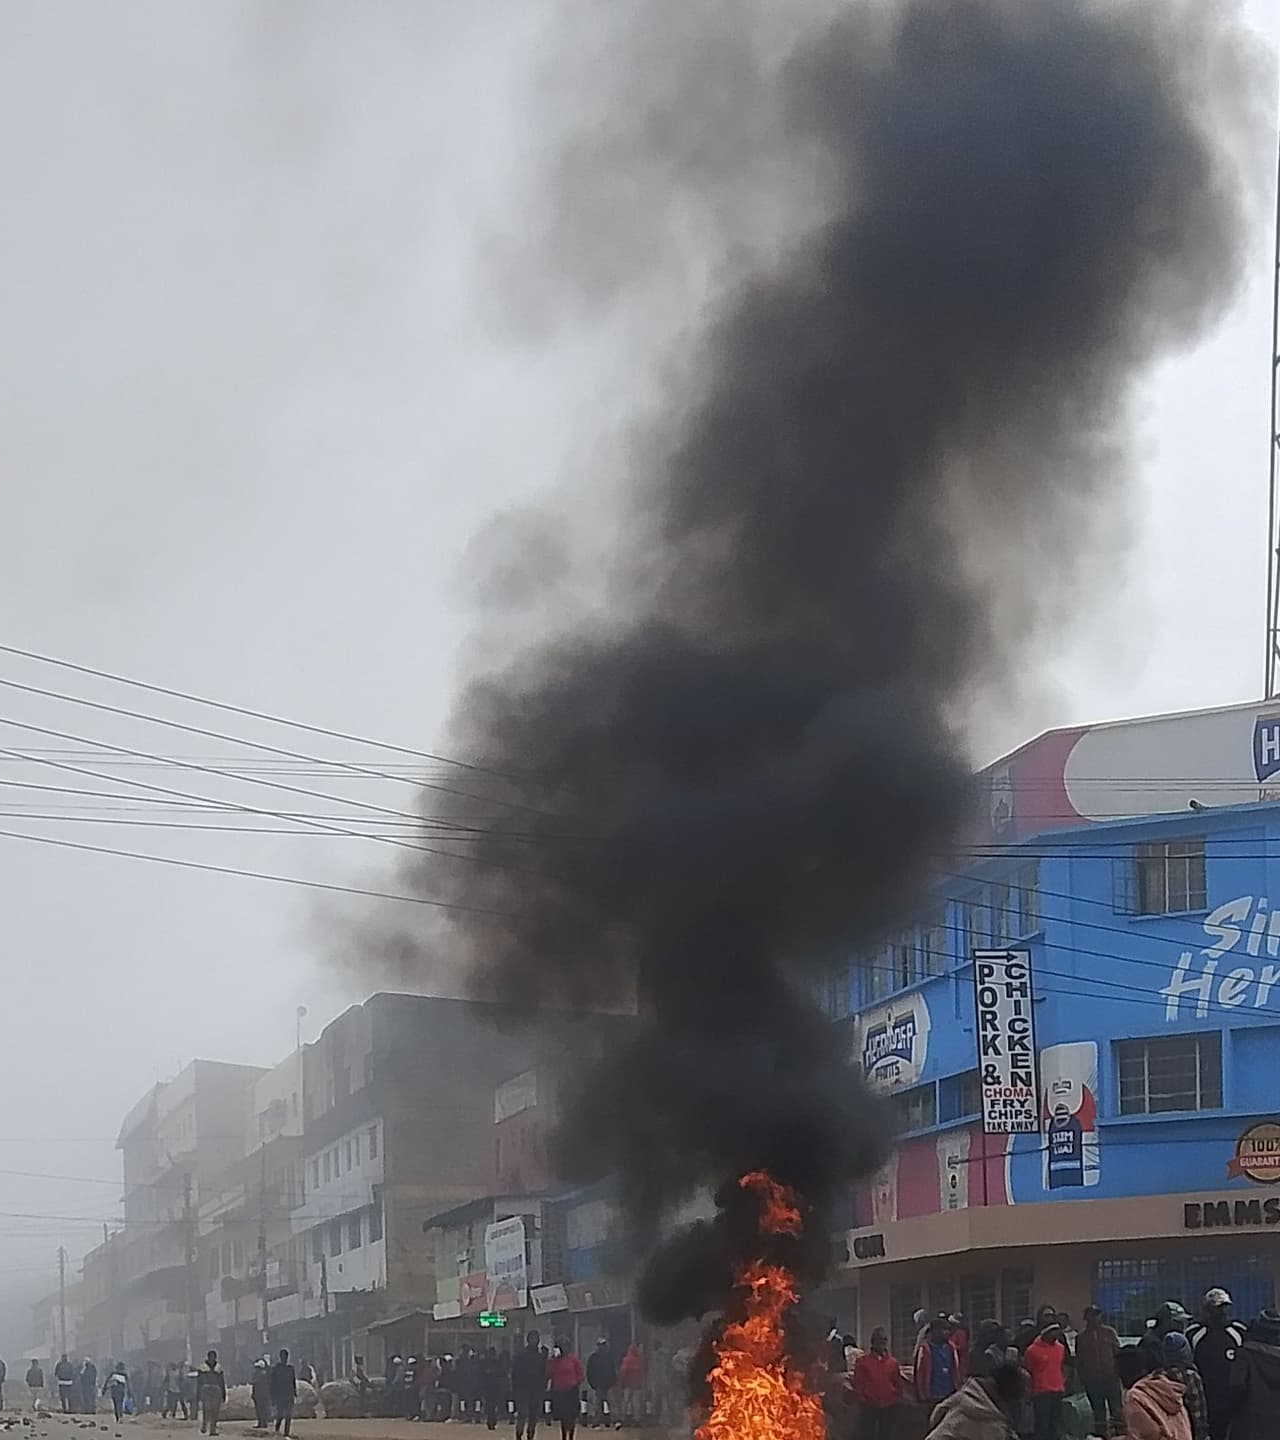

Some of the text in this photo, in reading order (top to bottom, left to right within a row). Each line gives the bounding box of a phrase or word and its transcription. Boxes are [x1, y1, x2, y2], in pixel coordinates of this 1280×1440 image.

[977, 963, 1003, 1057] PORK
[1004, 962, 1033, 1088] CHICKEN
[984, 1087, 1034, 1099] CHOMA
[989, 1098, 1029, 1110] FRY
[986, 1120, 1035, 1132] TAKE AWAY
